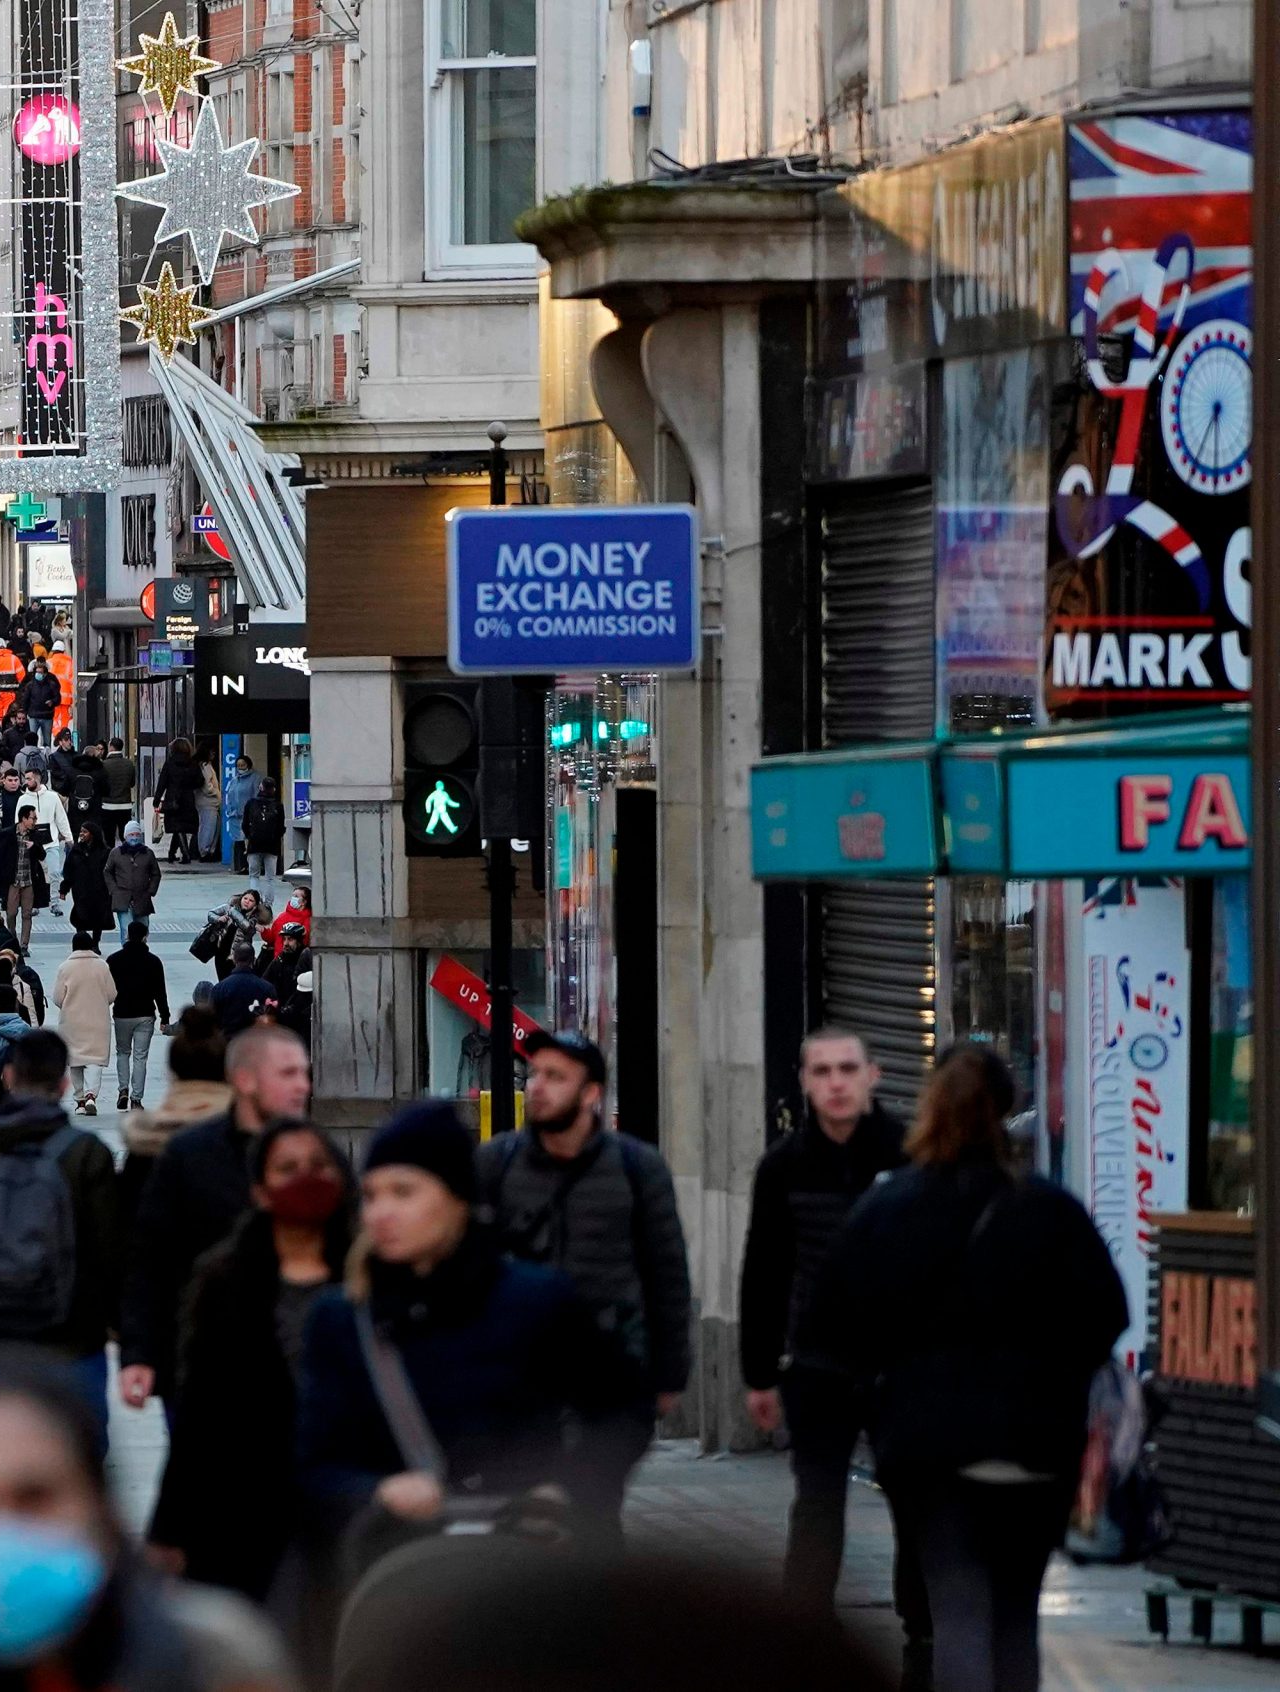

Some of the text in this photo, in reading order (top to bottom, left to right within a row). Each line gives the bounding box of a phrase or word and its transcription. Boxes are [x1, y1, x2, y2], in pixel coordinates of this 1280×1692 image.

[28, 281, 73, 404] hmv
[121, 498, 153, 565] VOICE
[198, 518, 219, 529] UN
[495, 541, 651, 578] MONEY
[47, 572, 73, 581] Cookies
[476, 579, 673, 614] EXCHANGE
[165, 615, 193, 624] Foreign
[165, 624, 200, 633] Exchange
[474, 614, 677, 639] 0% COMMISSION
[211, 675, 244, 695] IN
[1117, 772, 1249, 852] FA
[459, 983, 479, 1003] UP
